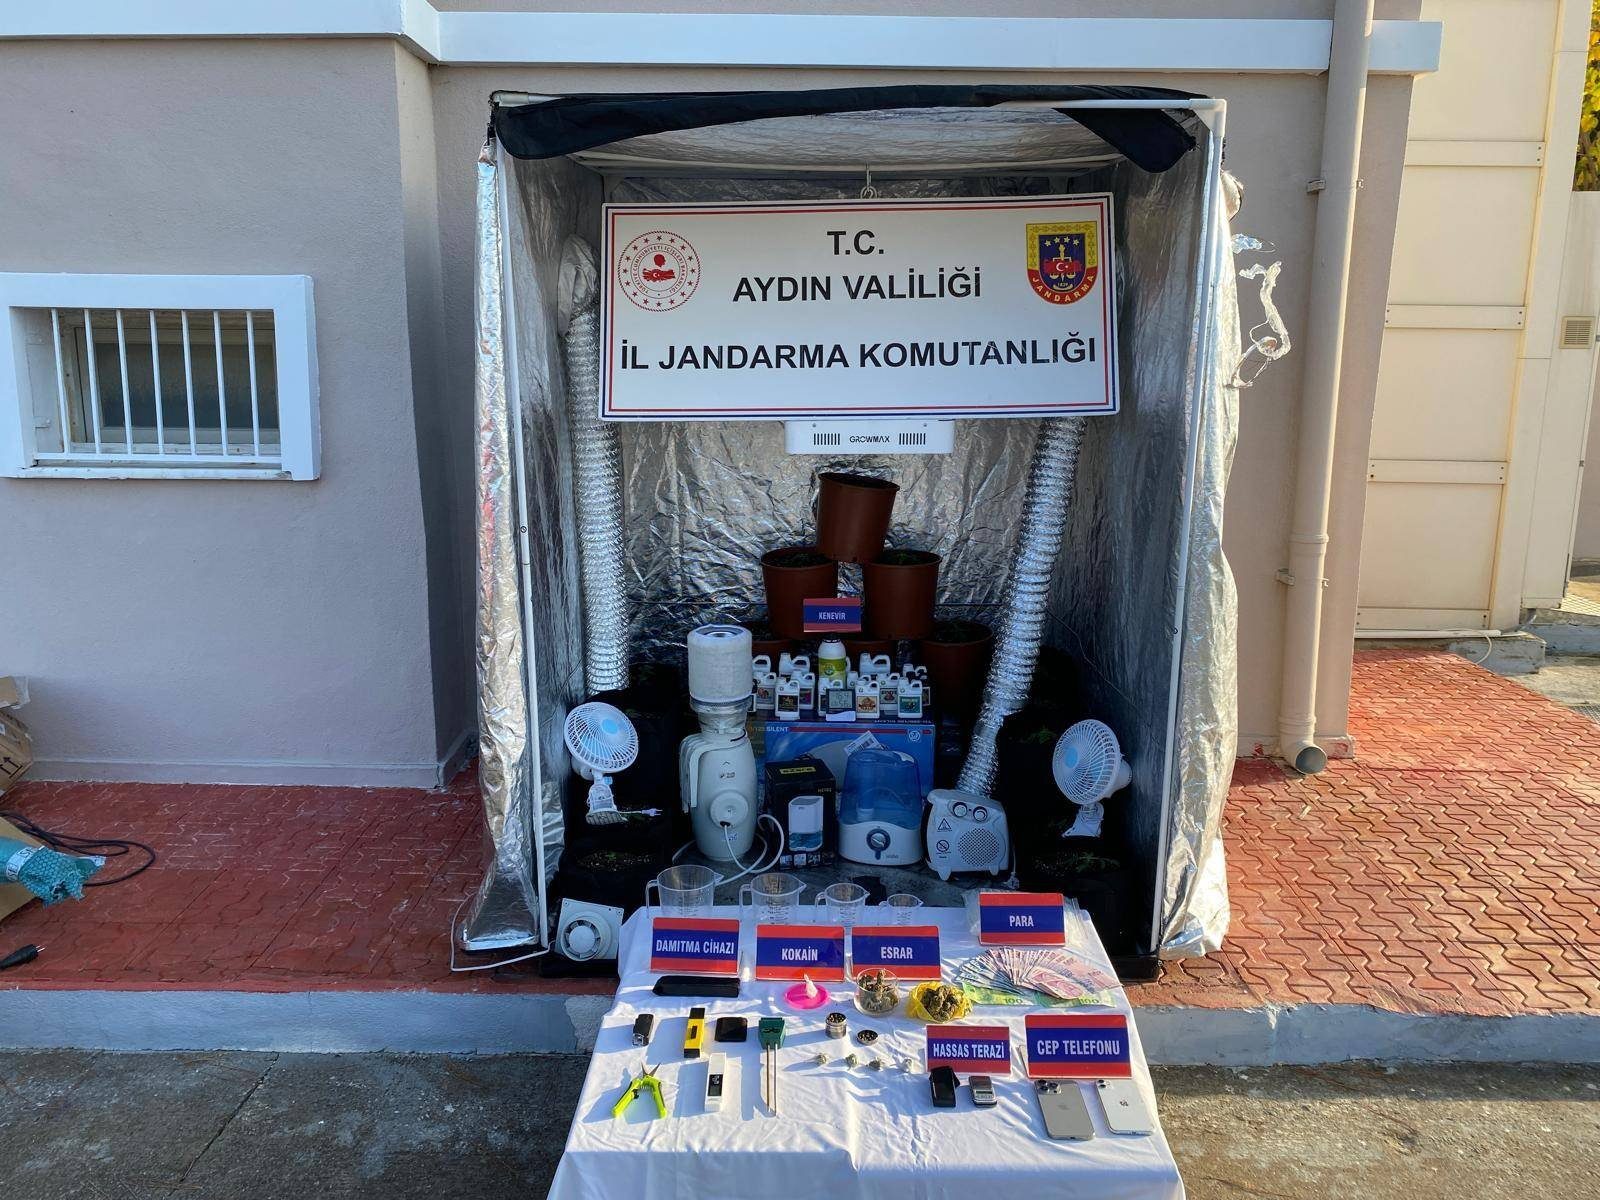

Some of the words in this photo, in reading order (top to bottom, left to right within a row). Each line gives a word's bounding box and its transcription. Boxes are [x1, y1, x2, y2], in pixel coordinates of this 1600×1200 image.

[826, 230, 885, 256] T.C.
[732, 276, 831, 302] AYDIN
[842, 267, 981, 300] VALİLİĞİ
[1032, 275, 1095, 302] JANDARMA
[621, 339, 649, 370] İL
[658, 345, 850, 370] JANDARMA
[859, 332, 1096, 368] KOMUTANLIĞI
[849, 435, 890, 443] GROWMAX
[818, 611, 846, 620] KENEVİR
[1009, 915, 1035, 927] PARA
[655, 939, 700, 953] DAMITMA
[703, 938, 735, 955] CİHAZI
[781, 946, 818, 961] KOKAİN
[880, 946, 913, 960] ESRAR
[933, 1043, 970, 1058] HASSAS
[971, 1041, 1005, 1059] TERAZİ
[1036, 1039, 1060, 1056] CEP
[1062, 1039, 1121, 1056] TELEFONU
